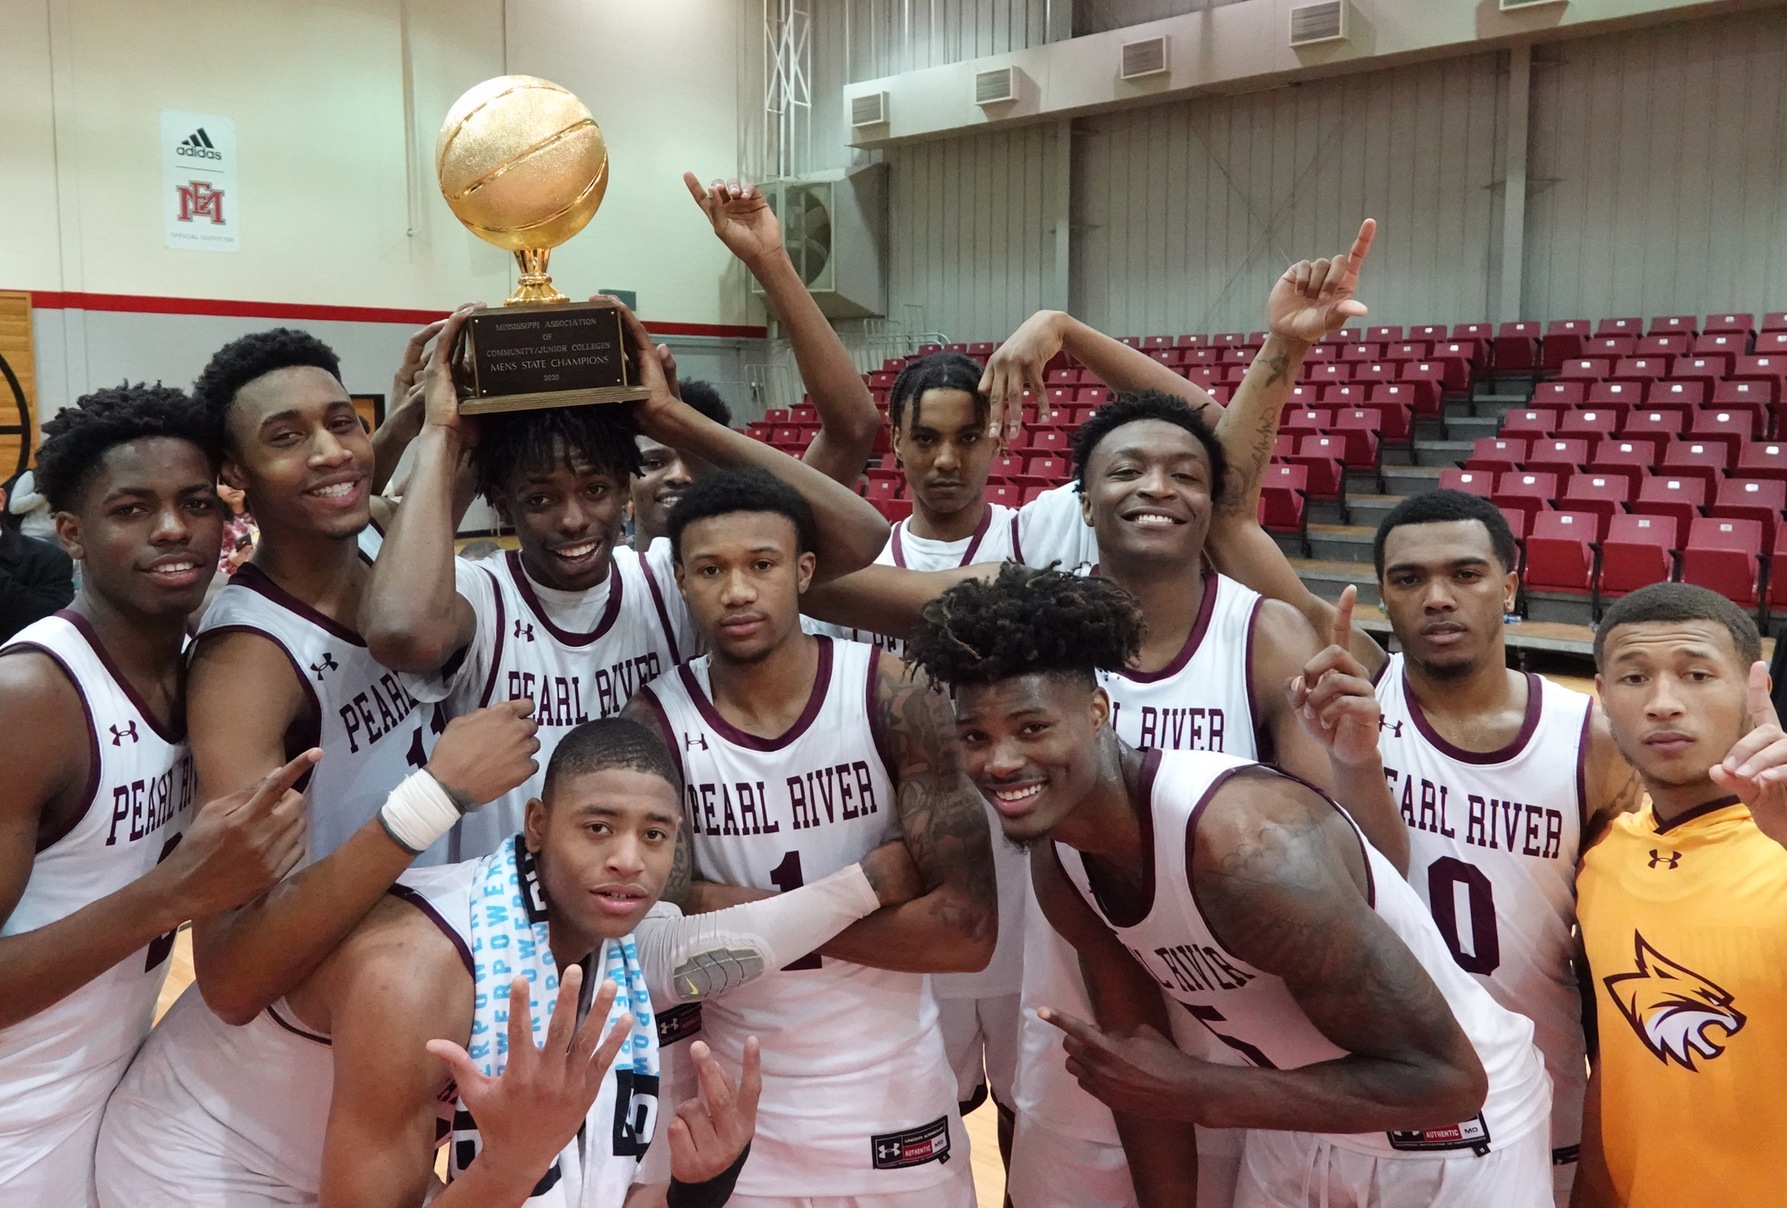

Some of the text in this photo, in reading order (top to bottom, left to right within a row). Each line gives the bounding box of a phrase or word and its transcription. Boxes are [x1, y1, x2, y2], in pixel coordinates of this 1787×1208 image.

[176, 146, 222, 160] adidas
[495, 318, 597, 331] MISSISSIPPI ASSOCIATION
[542, 333, 553, 341] OF
[486, 342, 611, 358] COMMUNITY/JUNIOR COLLEGES
[490, 356, 610, 372] MENS STATE CHAMPIONS
[543, 374, 560, 382] 2020
[508, 671, 589, 726] PEARL
[1140, 706, 1225, 753] RIVER
[687, 760, 878, 836] PEARL RIVER
[105, 768, 175, 846] PEARL
[1466, 794, 1563, 859] RIVER
[1427, 855, 1500, 976] 0
[1426, 1126, 1479, 1139] AUTHENTIC MD
[905, 1144, 932, 1157] AUTHENTIC
